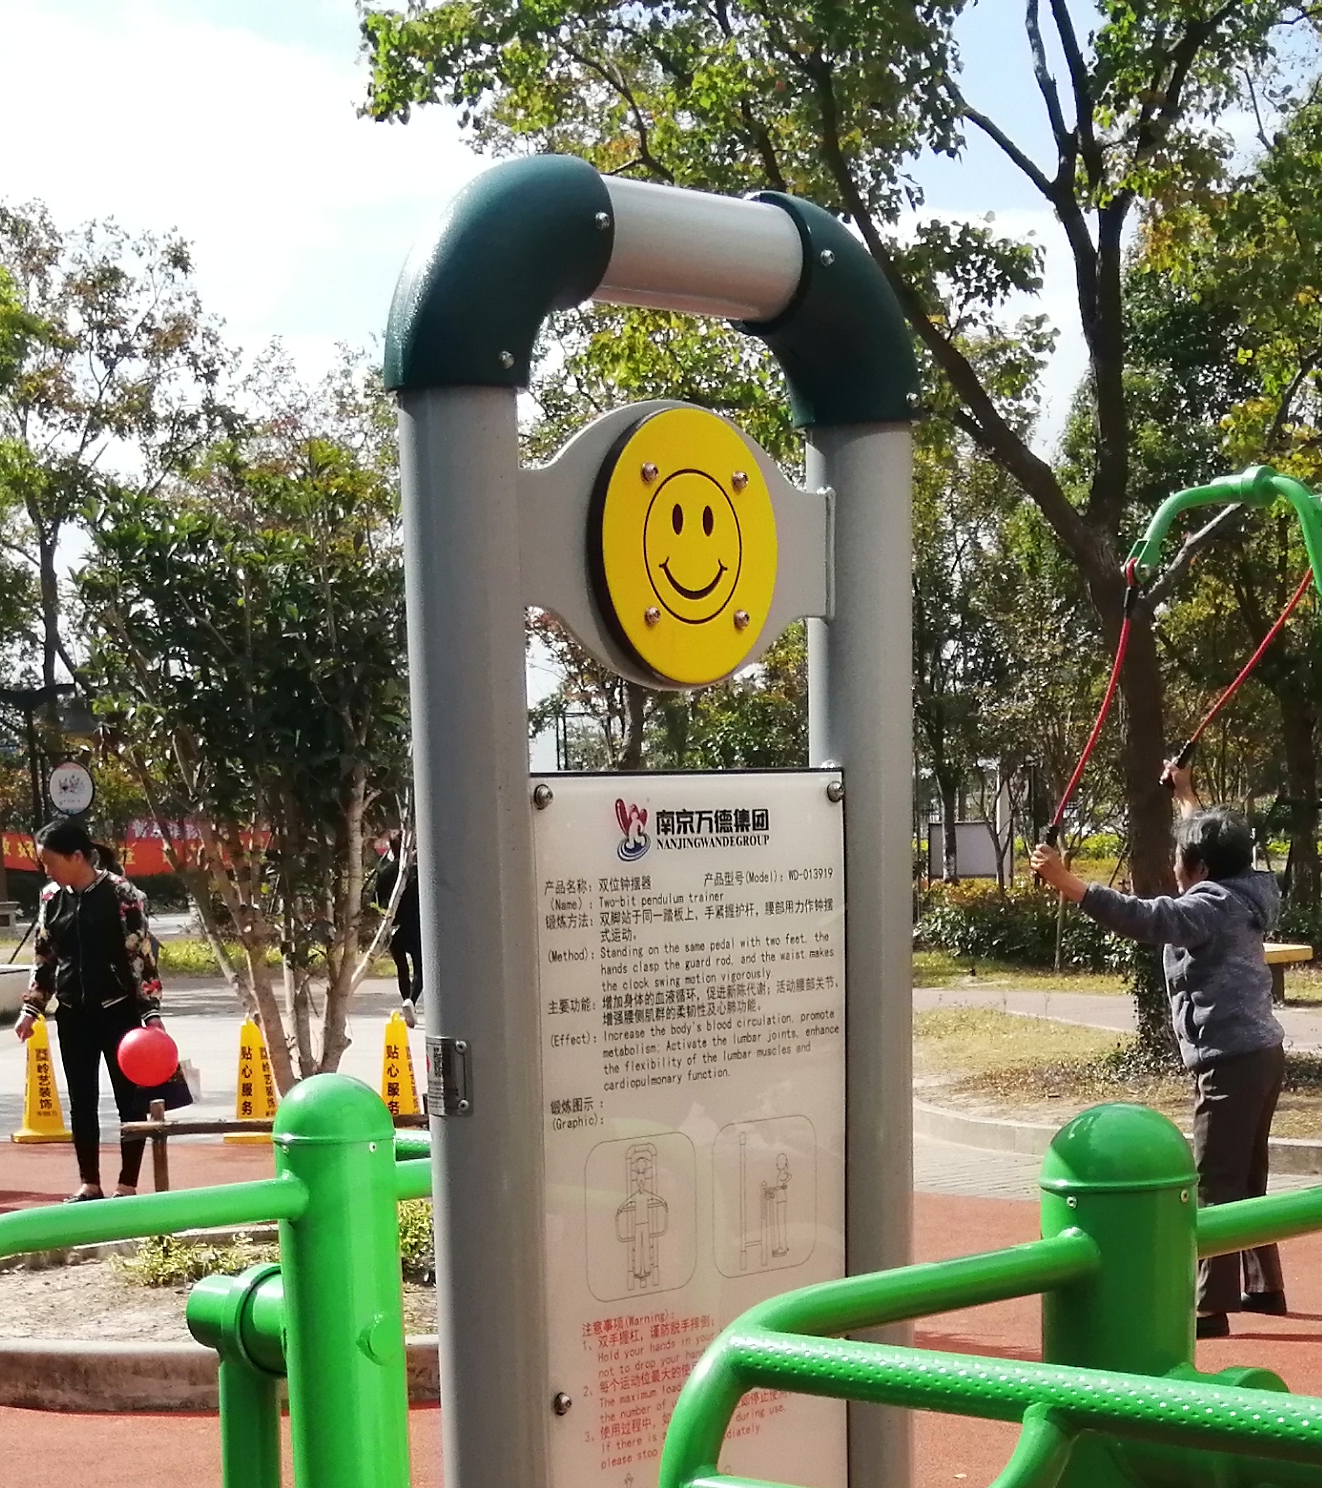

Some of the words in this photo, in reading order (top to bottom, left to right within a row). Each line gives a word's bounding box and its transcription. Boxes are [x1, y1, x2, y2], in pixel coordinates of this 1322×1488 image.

[656, 808, 770, 835] 南京万德集团
[657, 835, 770, 850] NANJINGWANDEGROUP
[599, 895, 637, 907] Two-bit
[643, 894, 684, 908] pendulum
[689, 892, 723, 903] trainer
[601, 946, 643, 958] Standing
[649, 947, 659, 955] on
[664, 943, 679, 954] the
[685, 943, 705, 952] same
[710, 939, 735, 953] pedal
[740, 937, 760, 948] with
[766, 936, 781, 946] two
[815, 932, 829, 943] the
[601, 963, 628, 975] hands
[633, 962, 659, 973] clasp
[665, 959, 679, 970] the
[685, 957, 710, 971] guard
[741, 953, 755, 964] and
[761, 952, 776, 962] the
[781, 949, 805, 961] waist
[810, 947, 834, 958] makes
[602, 980, 618, 991] the
[624, 978, 650, 989] clock
[655, 976, 680, 988] swing
[685, 973, 715, 985] motion
[604, 1029, 646, 1040] Increase
[652, 1025, 667, 1036] the
[672, 1022, 702, 1035] body's
[707, 1018, 732, 1030] blood
[801, 1008, 834, 1024] promote
[666, 1037, 706, 1050] Activate
[711, 1035, 726, 1046] the
[732, 1032, 761, 1044] lumbar
[806, 1025, 839, 1036] enhance
[604, 1063, 620, 1074] the
[626, 1056, 682, 1071] flexibility
[687, 1054, 697, 1065] of
[703, 1053, 717, 1063] the
[723, 1049, 752, 1061] lumbar
[758, 1045, 791, 1057] muscles
[796, 1042, 810, 1053] and
[241, 1046, 253, 1115] 贴心服务
[386, 1045, 400, 1115] 贴心服务
[604, 1074, 682, 1090] cardiopulmonary
[598, 1349, 620, 1362] Hold
[625, 1347, 645, 1360] your
[650, 1340, 675, 1353] hands
[680, 1337, 690, 1347] in
[695, 1334, 714, 1347] your
[599, 1365, 615, 1377] not
[621, 1363, 631, 1373] to
[636, 1360, 656, 1370] drop
[661, 1355, 681, 1368] your
[600, 1396, 616, 1407] The
[622, 1390, 657, 1403] maximum
[600, 1411, 616, 1422] the
[622, 1405, 651, 1418] number
[656, 1400, 665, 1412] of
[602, 1441, 613, 1453] If
[618, 1437, 643, 1449] there
[648, 1433, 657, 1443] is
[736, 1408, 764, 1422] during
[601, 1454, 633, 1470] please
[639, 1448, 658, 1459] stop
